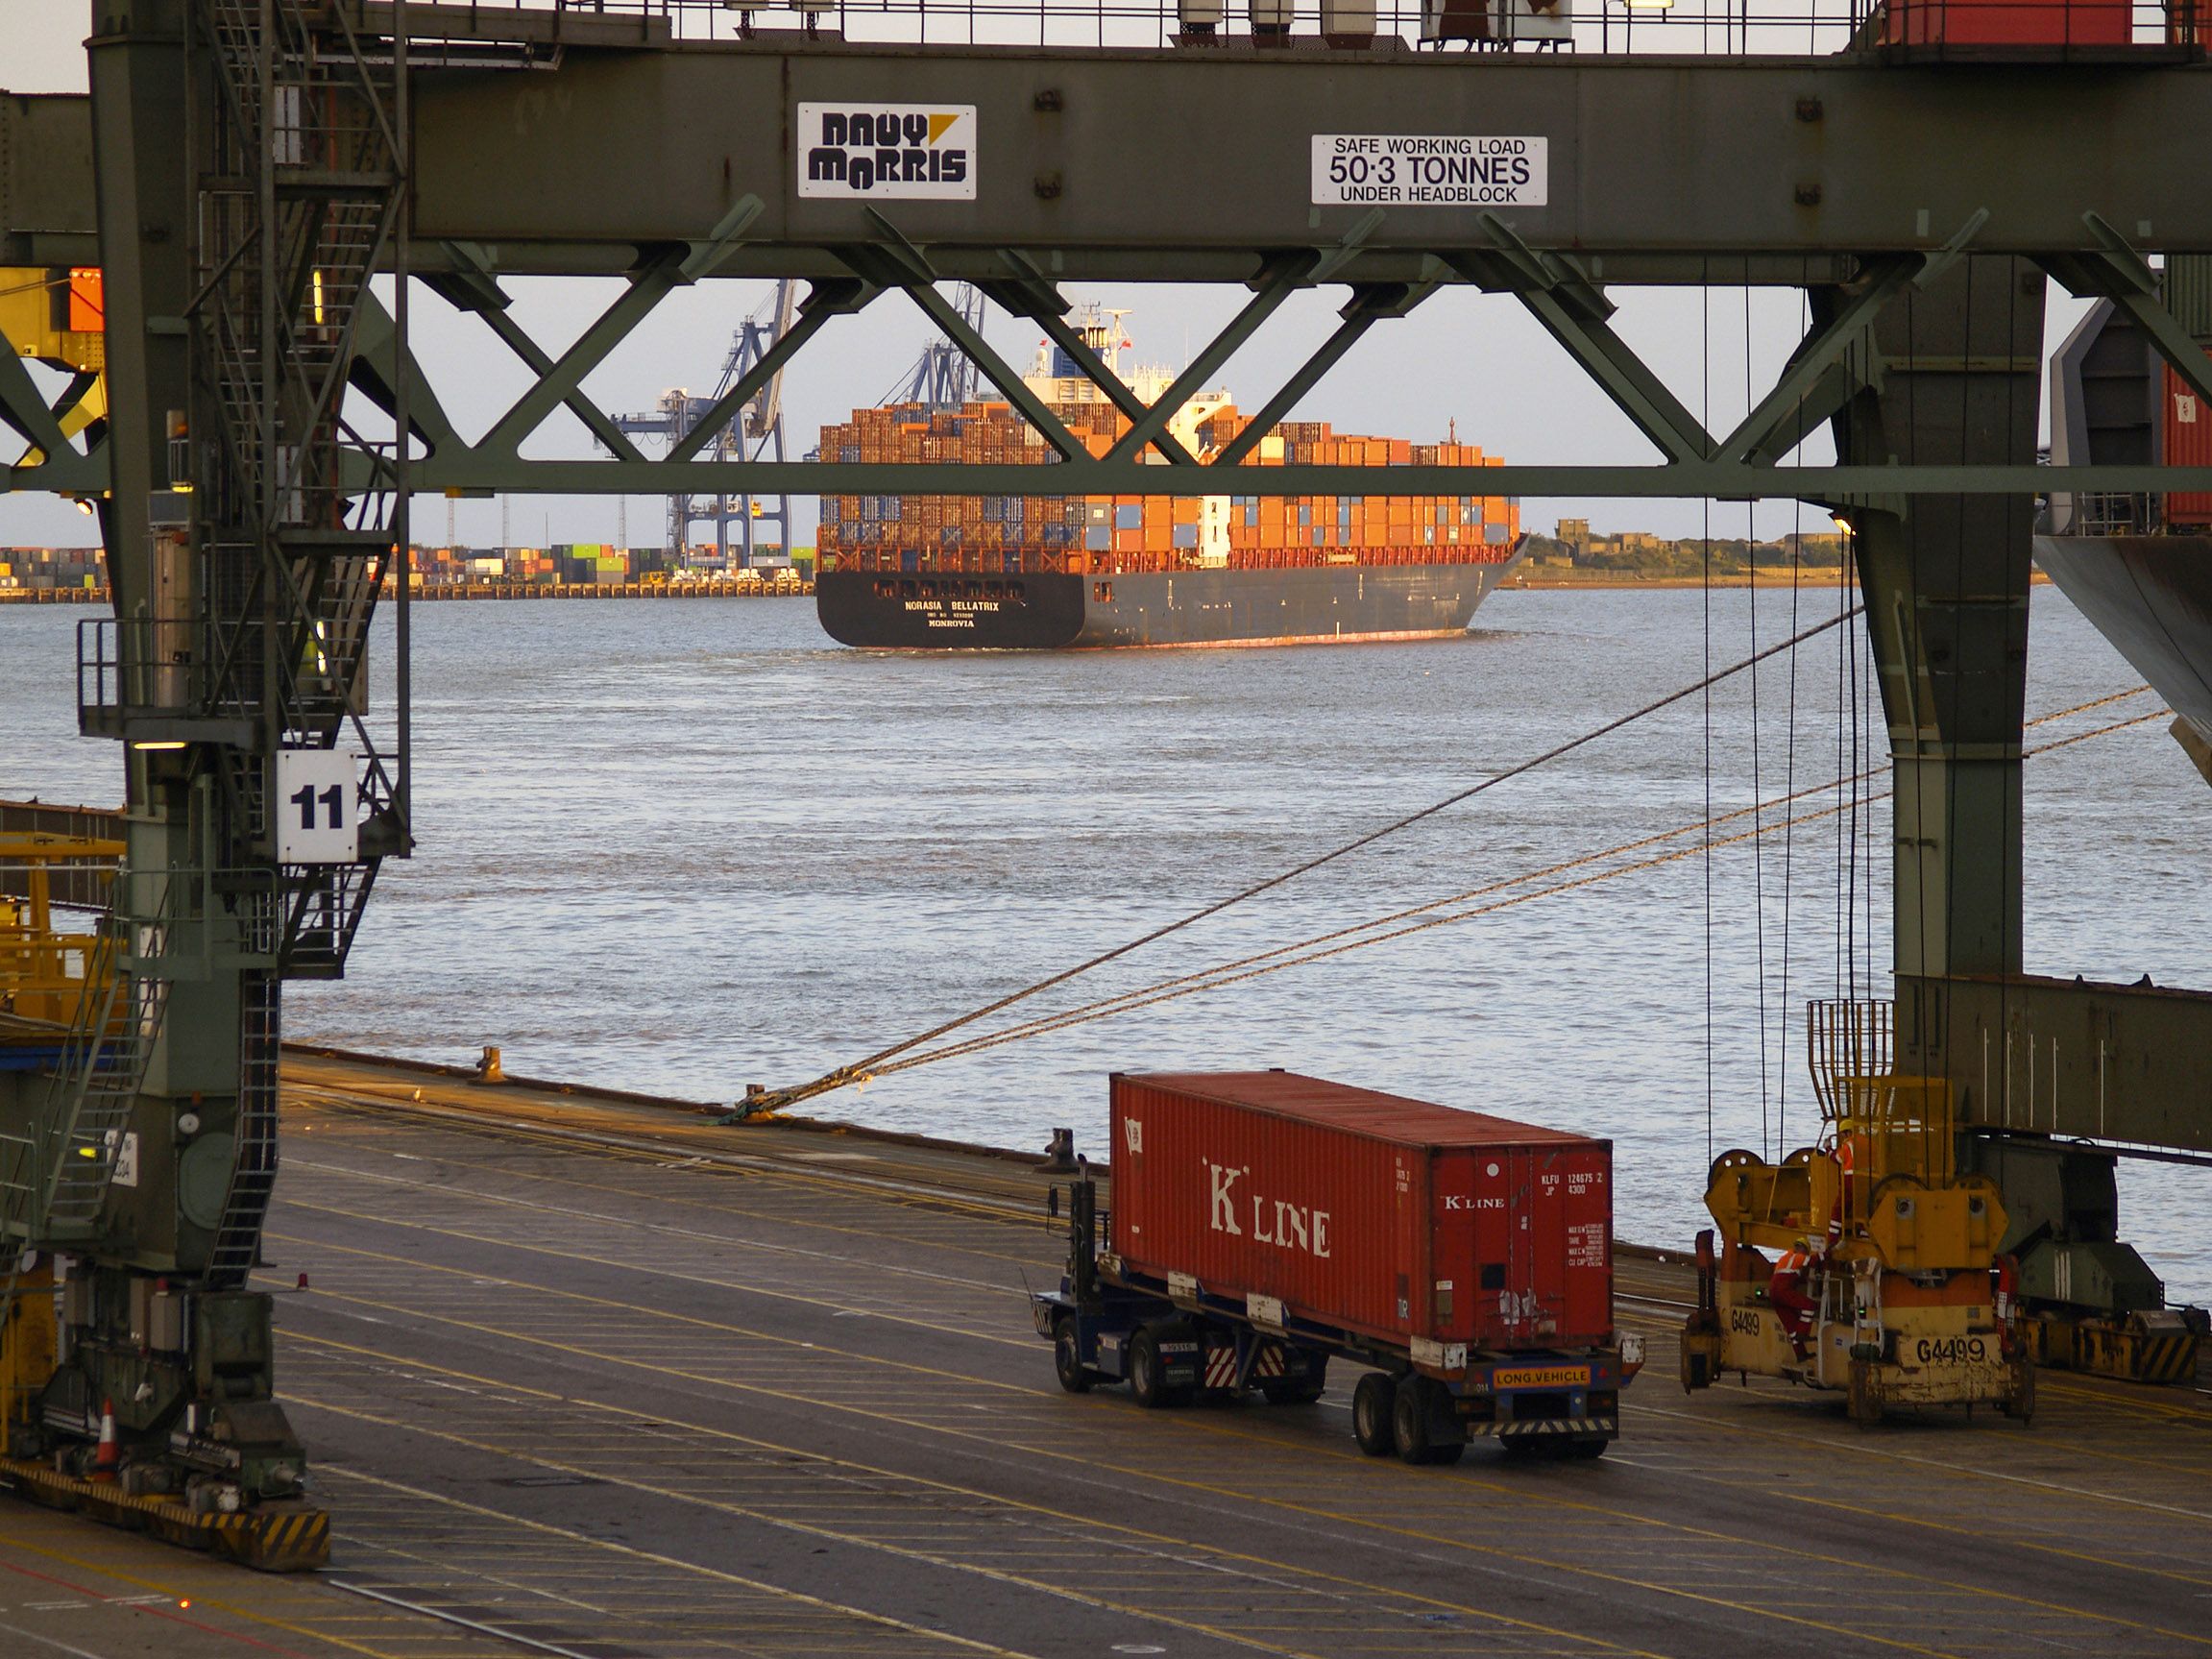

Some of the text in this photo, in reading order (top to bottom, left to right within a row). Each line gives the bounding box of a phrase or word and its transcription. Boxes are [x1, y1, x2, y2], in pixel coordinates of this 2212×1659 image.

[822, 112, 928, 147] DAVY
[1335, 138, 1525, 155] SAFE WORKING LOAD
[809, 148, 966, 190] MORRIS
[1407, 156, 1530, 184] TONNES
[1341, 186, 1518, 202] UNDER HEADBLOCK
[905, 600, 999, 612] NORASIA BELLATRIX
[291, 784, 343, 830] 11
[1597, 1172, 1603, 1183] 2
[1466, 1198, 1505, 1208] LINE
[1252, 1195, 1330, 1257] LINE
[1731, 1307, 1760, 1337] G4499
[1916, 1337, 1985, 1363] G4499
[1496, 1370, 1587, 1385] LONG VEHICLE
